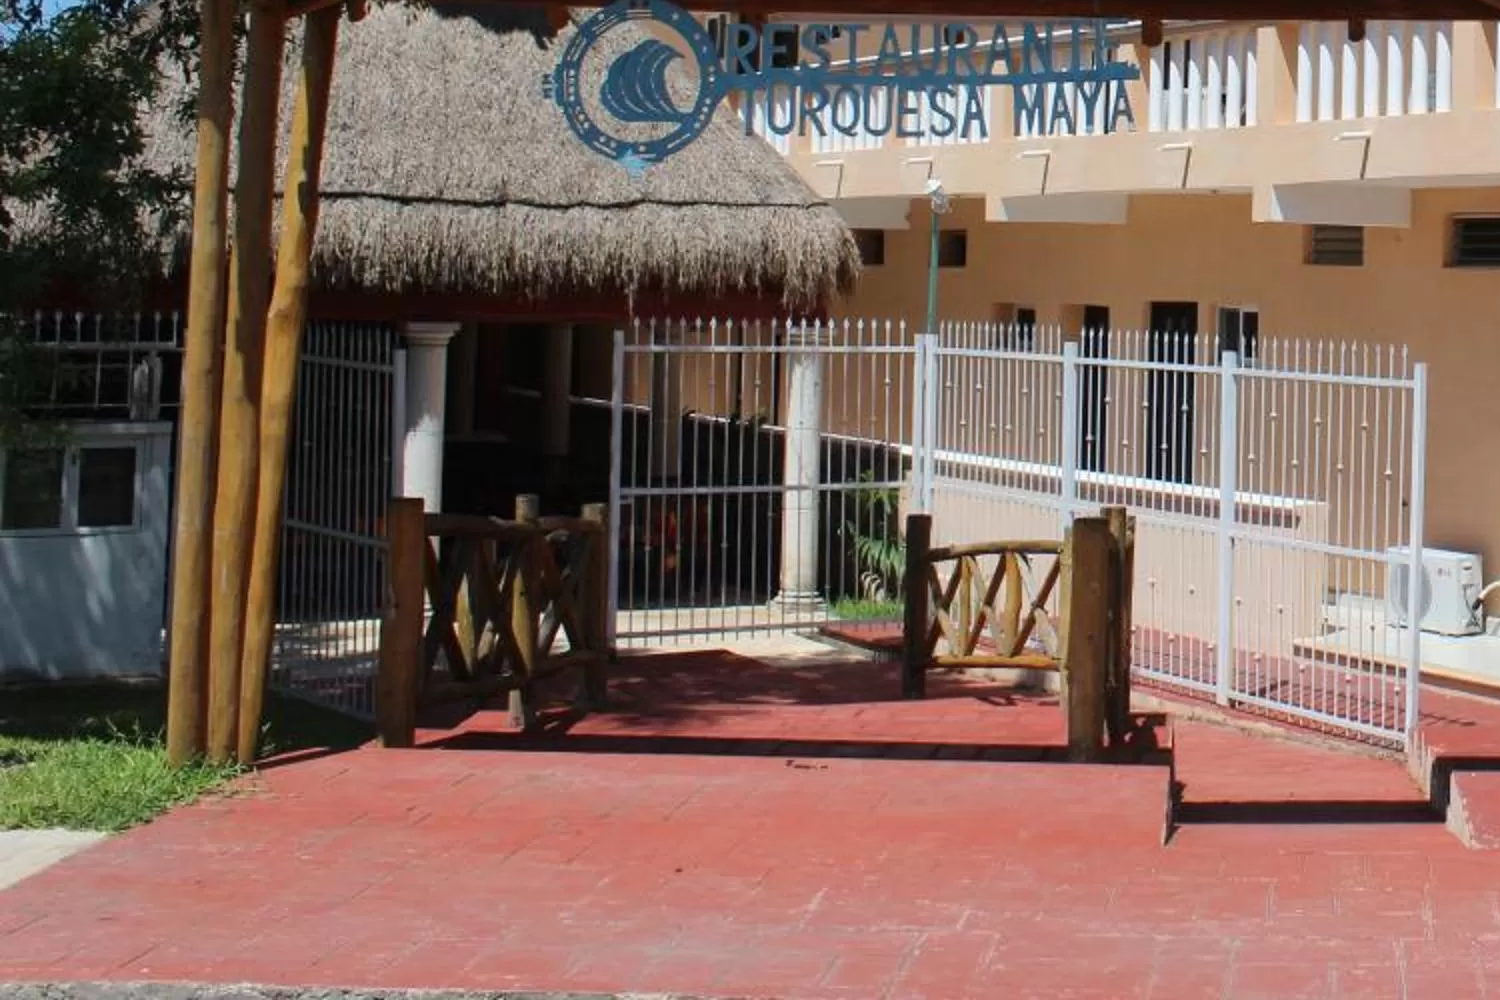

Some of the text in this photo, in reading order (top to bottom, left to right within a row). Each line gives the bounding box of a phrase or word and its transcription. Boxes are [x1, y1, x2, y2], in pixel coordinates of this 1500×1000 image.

[726, 20, 1130, 75] RESTAURANTE
[740, 79, 1136, 138] TURQUESA MAYA
